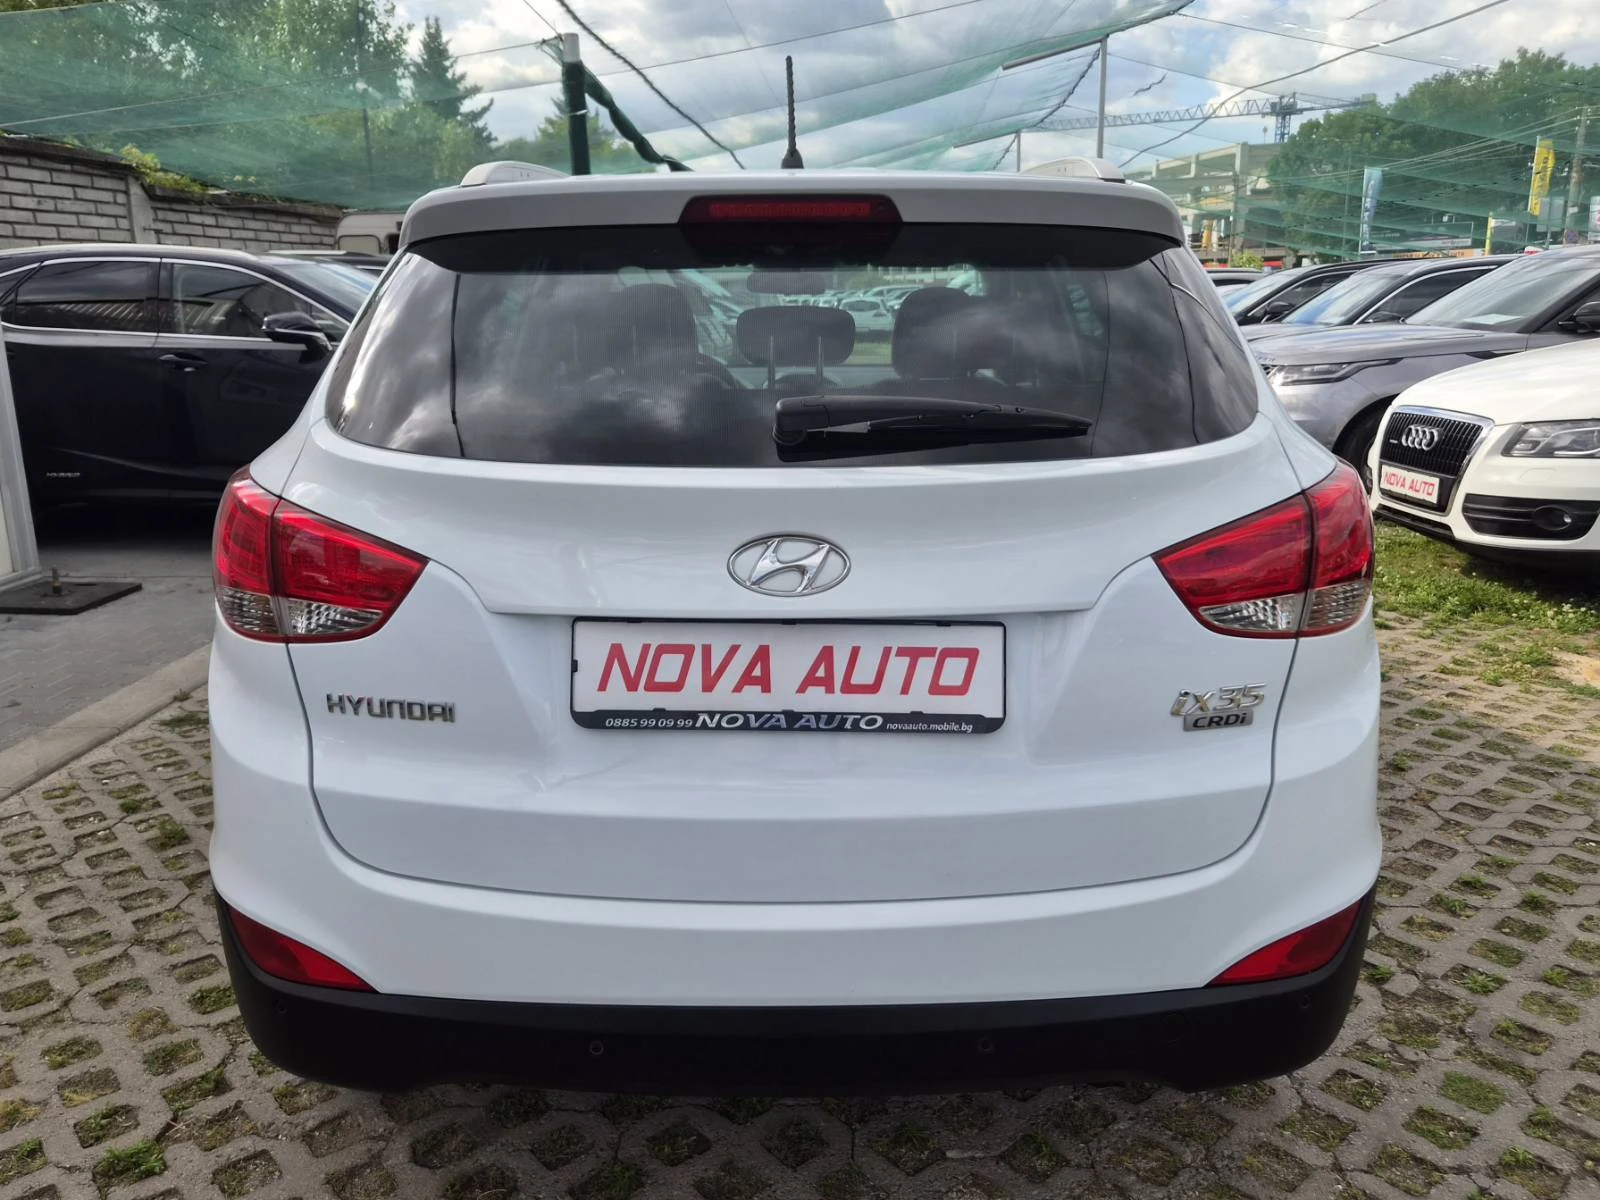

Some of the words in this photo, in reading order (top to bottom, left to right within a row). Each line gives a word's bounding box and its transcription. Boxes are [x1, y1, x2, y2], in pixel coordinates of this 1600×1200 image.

[1384, 471, 1406, 489] NOVA
[1408, 478, 1436, 497] AUTO
[596, 642, 771, 694] NOVA
[795, 645, 980, 696] AUTO
[325, 692, 456, 723] HYUNDAI
[1192, 712, 1248, 729] CRDi
[605, 717, 638, 727] 0885
[639, 718, 656, 728] 99
[657, 718, 674, 728] 09
[677, 718, 693, 728] 99
[694, 712, 788, 729] NOVA
[793, 713, 884, 730] AUTO
[886, 721, 973, 734] novaauto.mobile.bg
